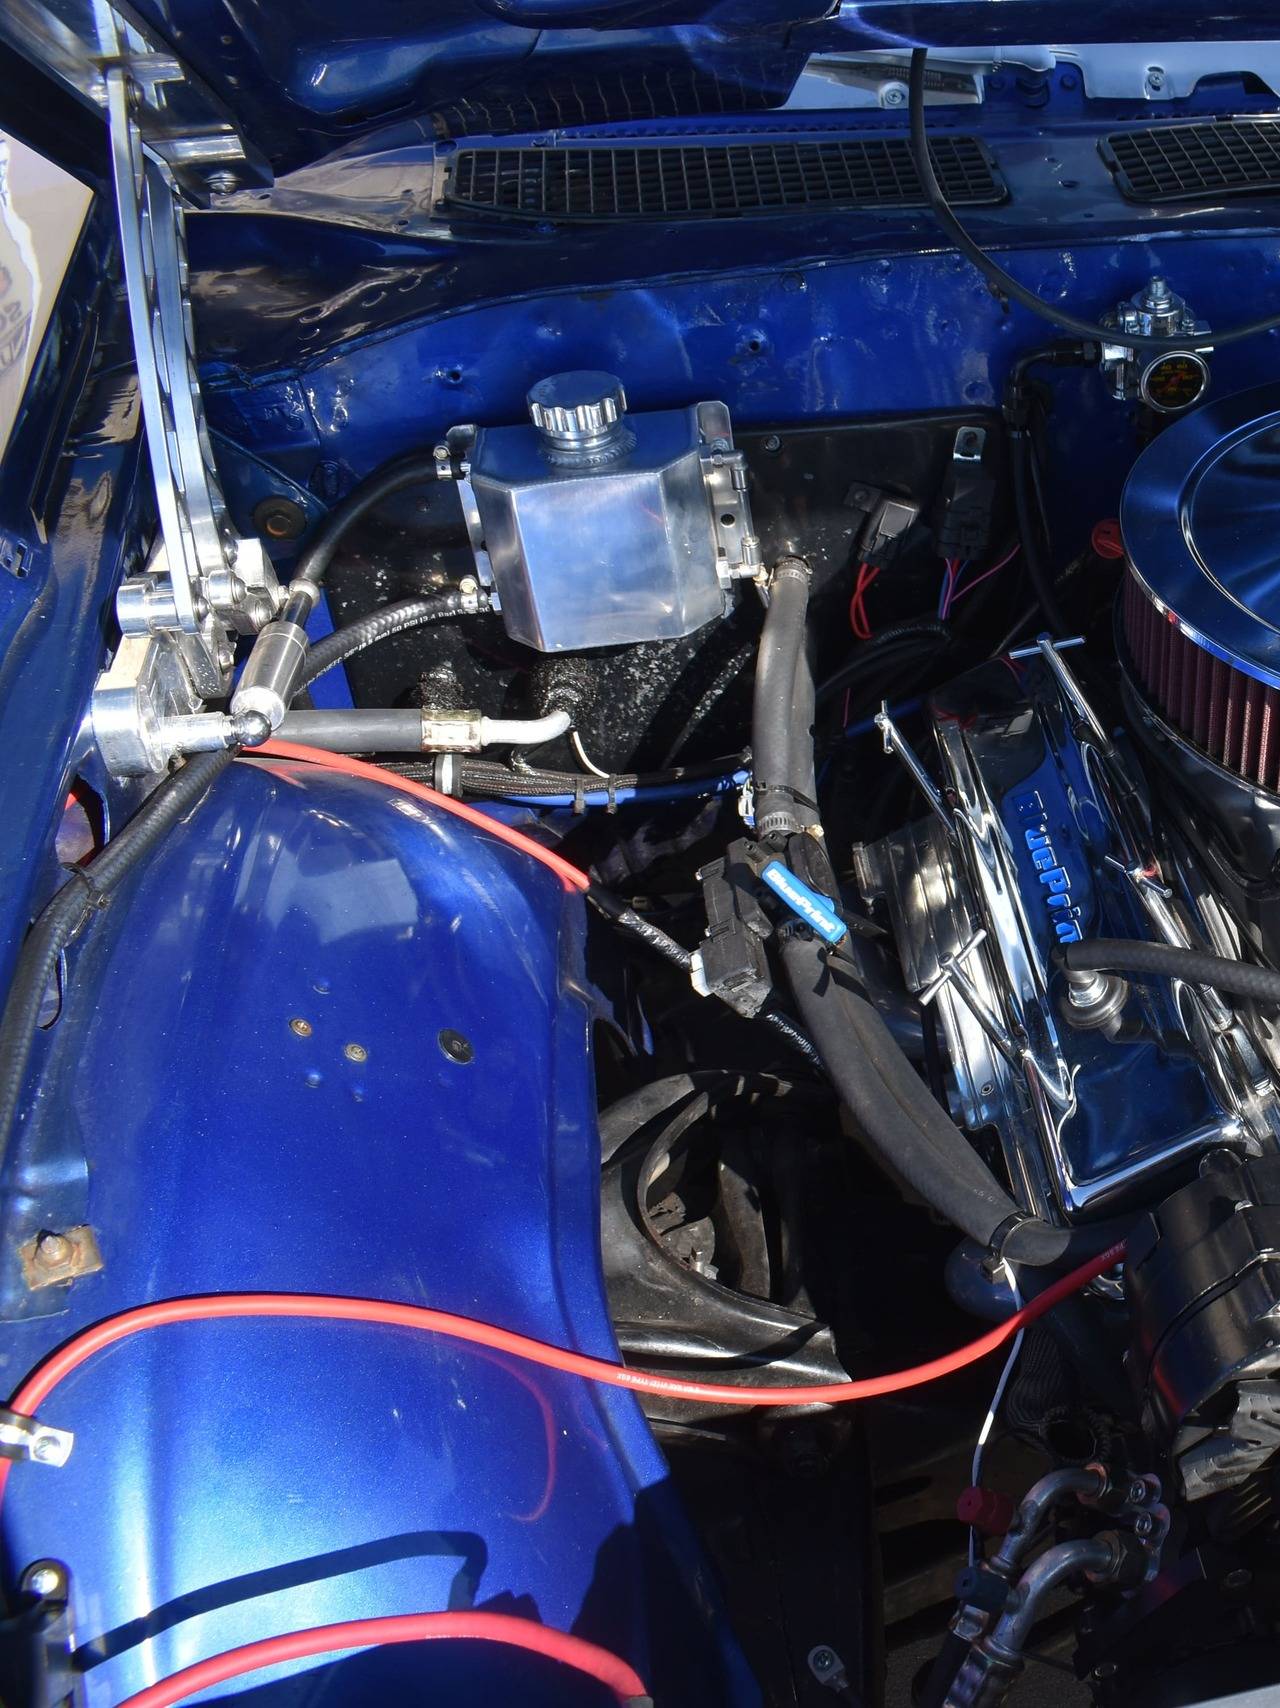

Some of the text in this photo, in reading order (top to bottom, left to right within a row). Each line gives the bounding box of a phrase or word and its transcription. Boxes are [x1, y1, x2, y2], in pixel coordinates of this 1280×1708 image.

[403, 617, 418, 629] PSI
[1013, 790, 1084, 944] BluePrin
[766, 868, 836, 933] BluePrint
